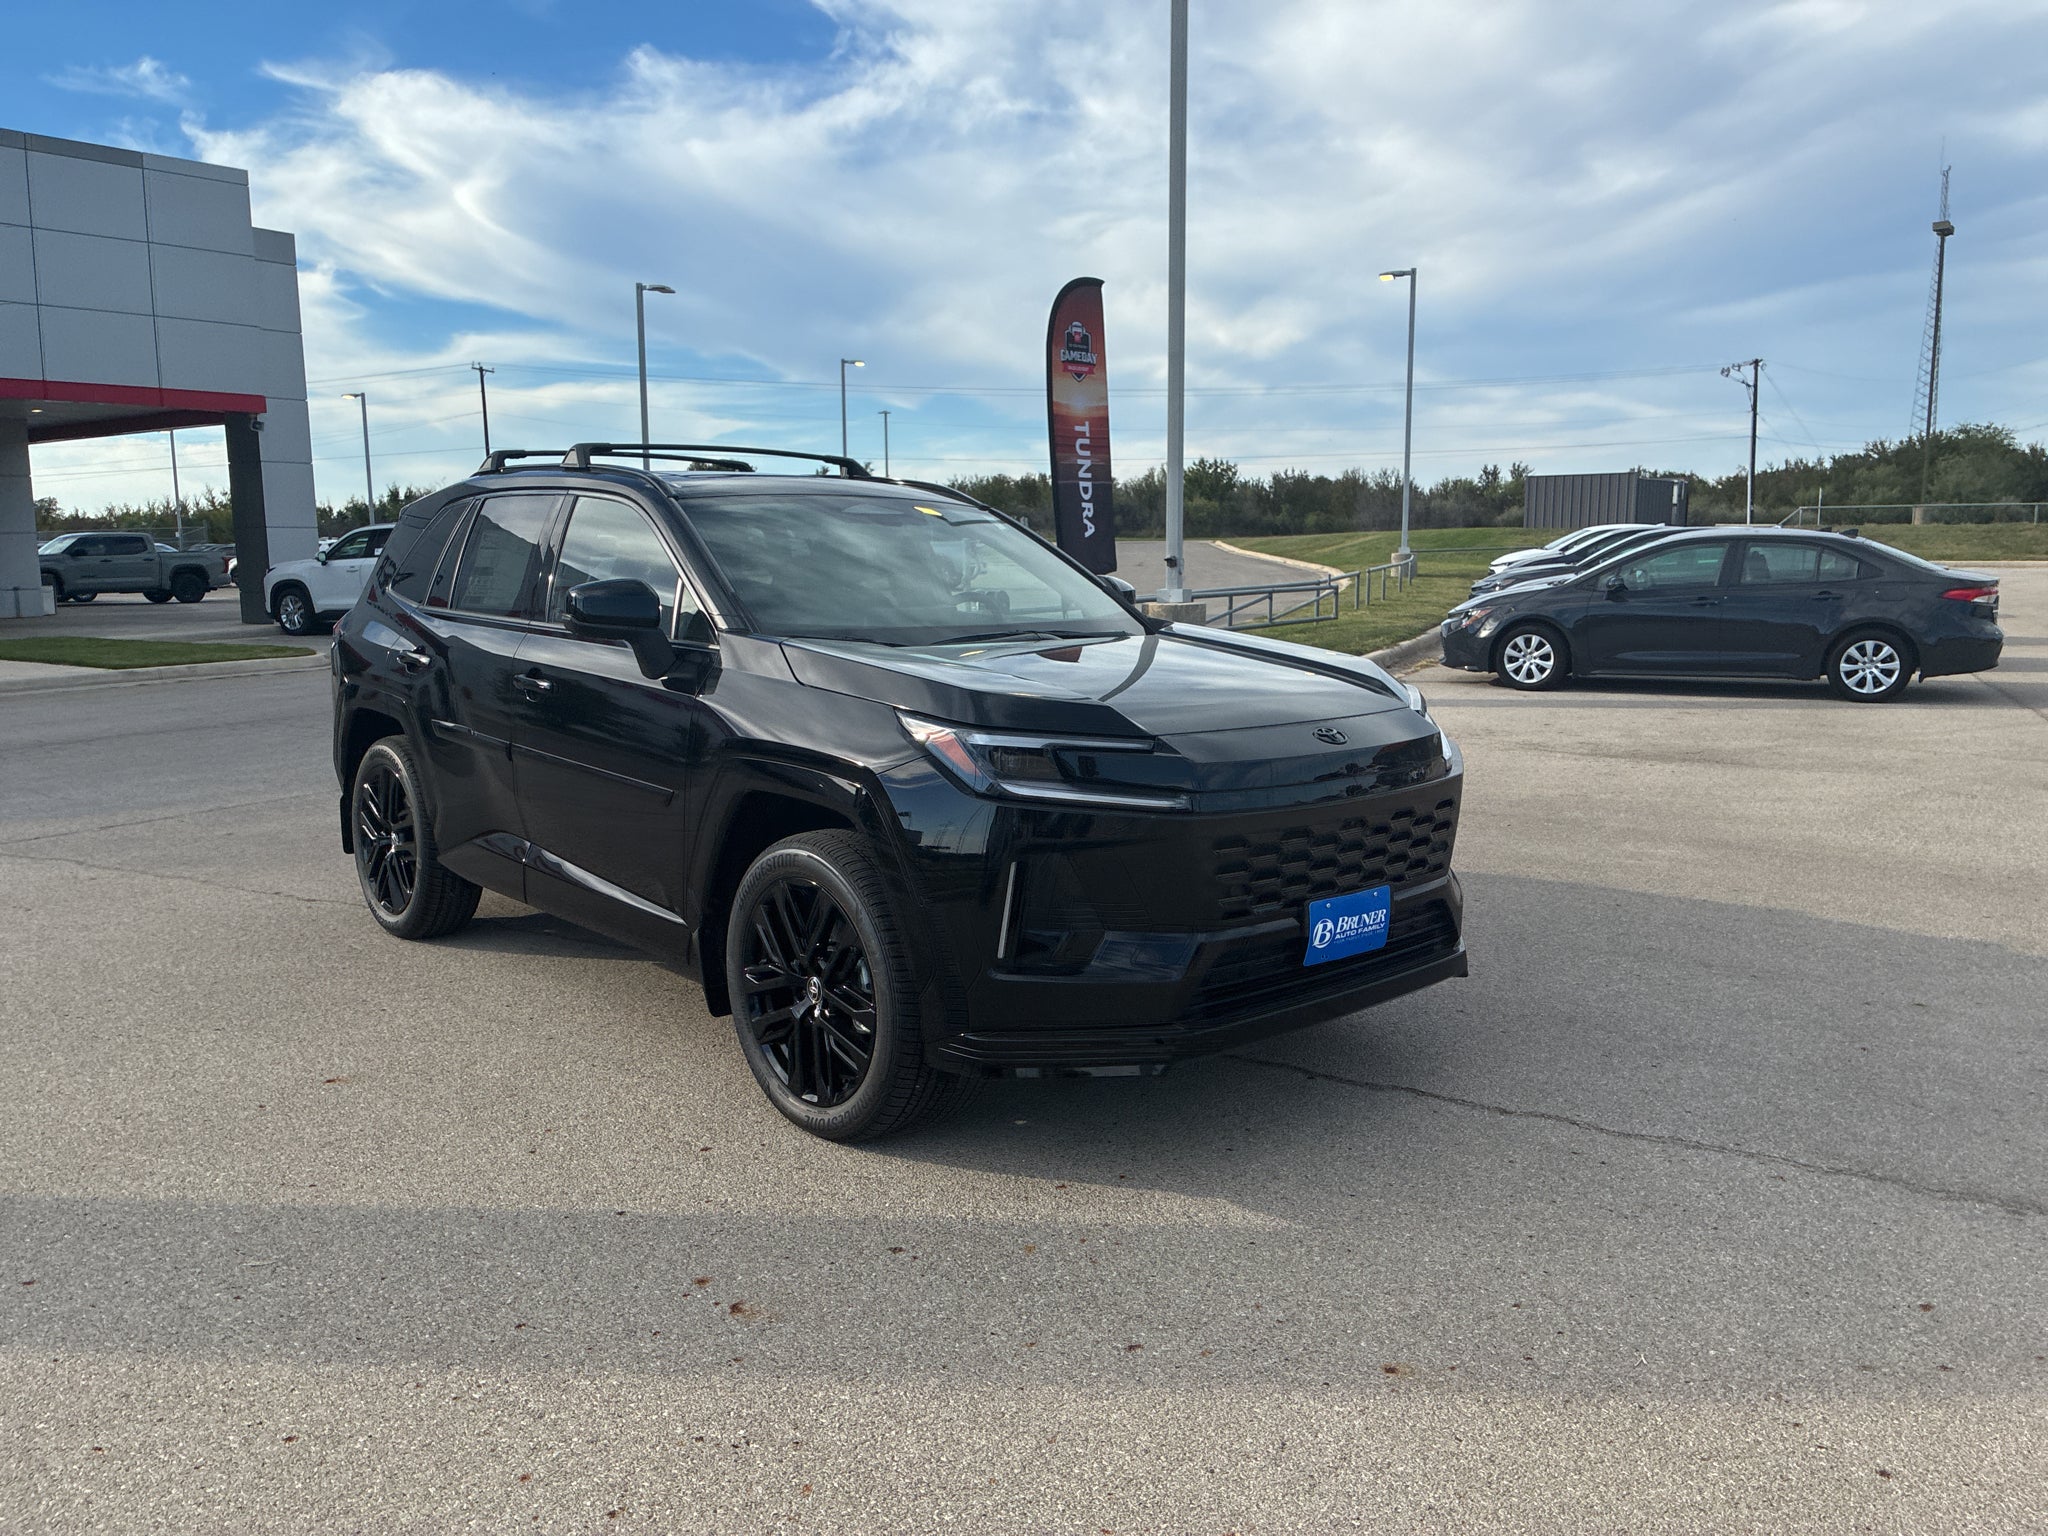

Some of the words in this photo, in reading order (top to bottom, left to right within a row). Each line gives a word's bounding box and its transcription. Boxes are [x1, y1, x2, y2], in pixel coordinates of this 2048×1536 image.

[1060, 347, 1097, 364] GAMEDAY
[1074, 421, 1096, 538] TUNDRA
[1335, 929, 1357, 940] AUTO
[1357, 922, 1386, 934] FAMILY
[1336, 909, 1387, 933] BRUNER
[1312, 920, 1333, 947] B
